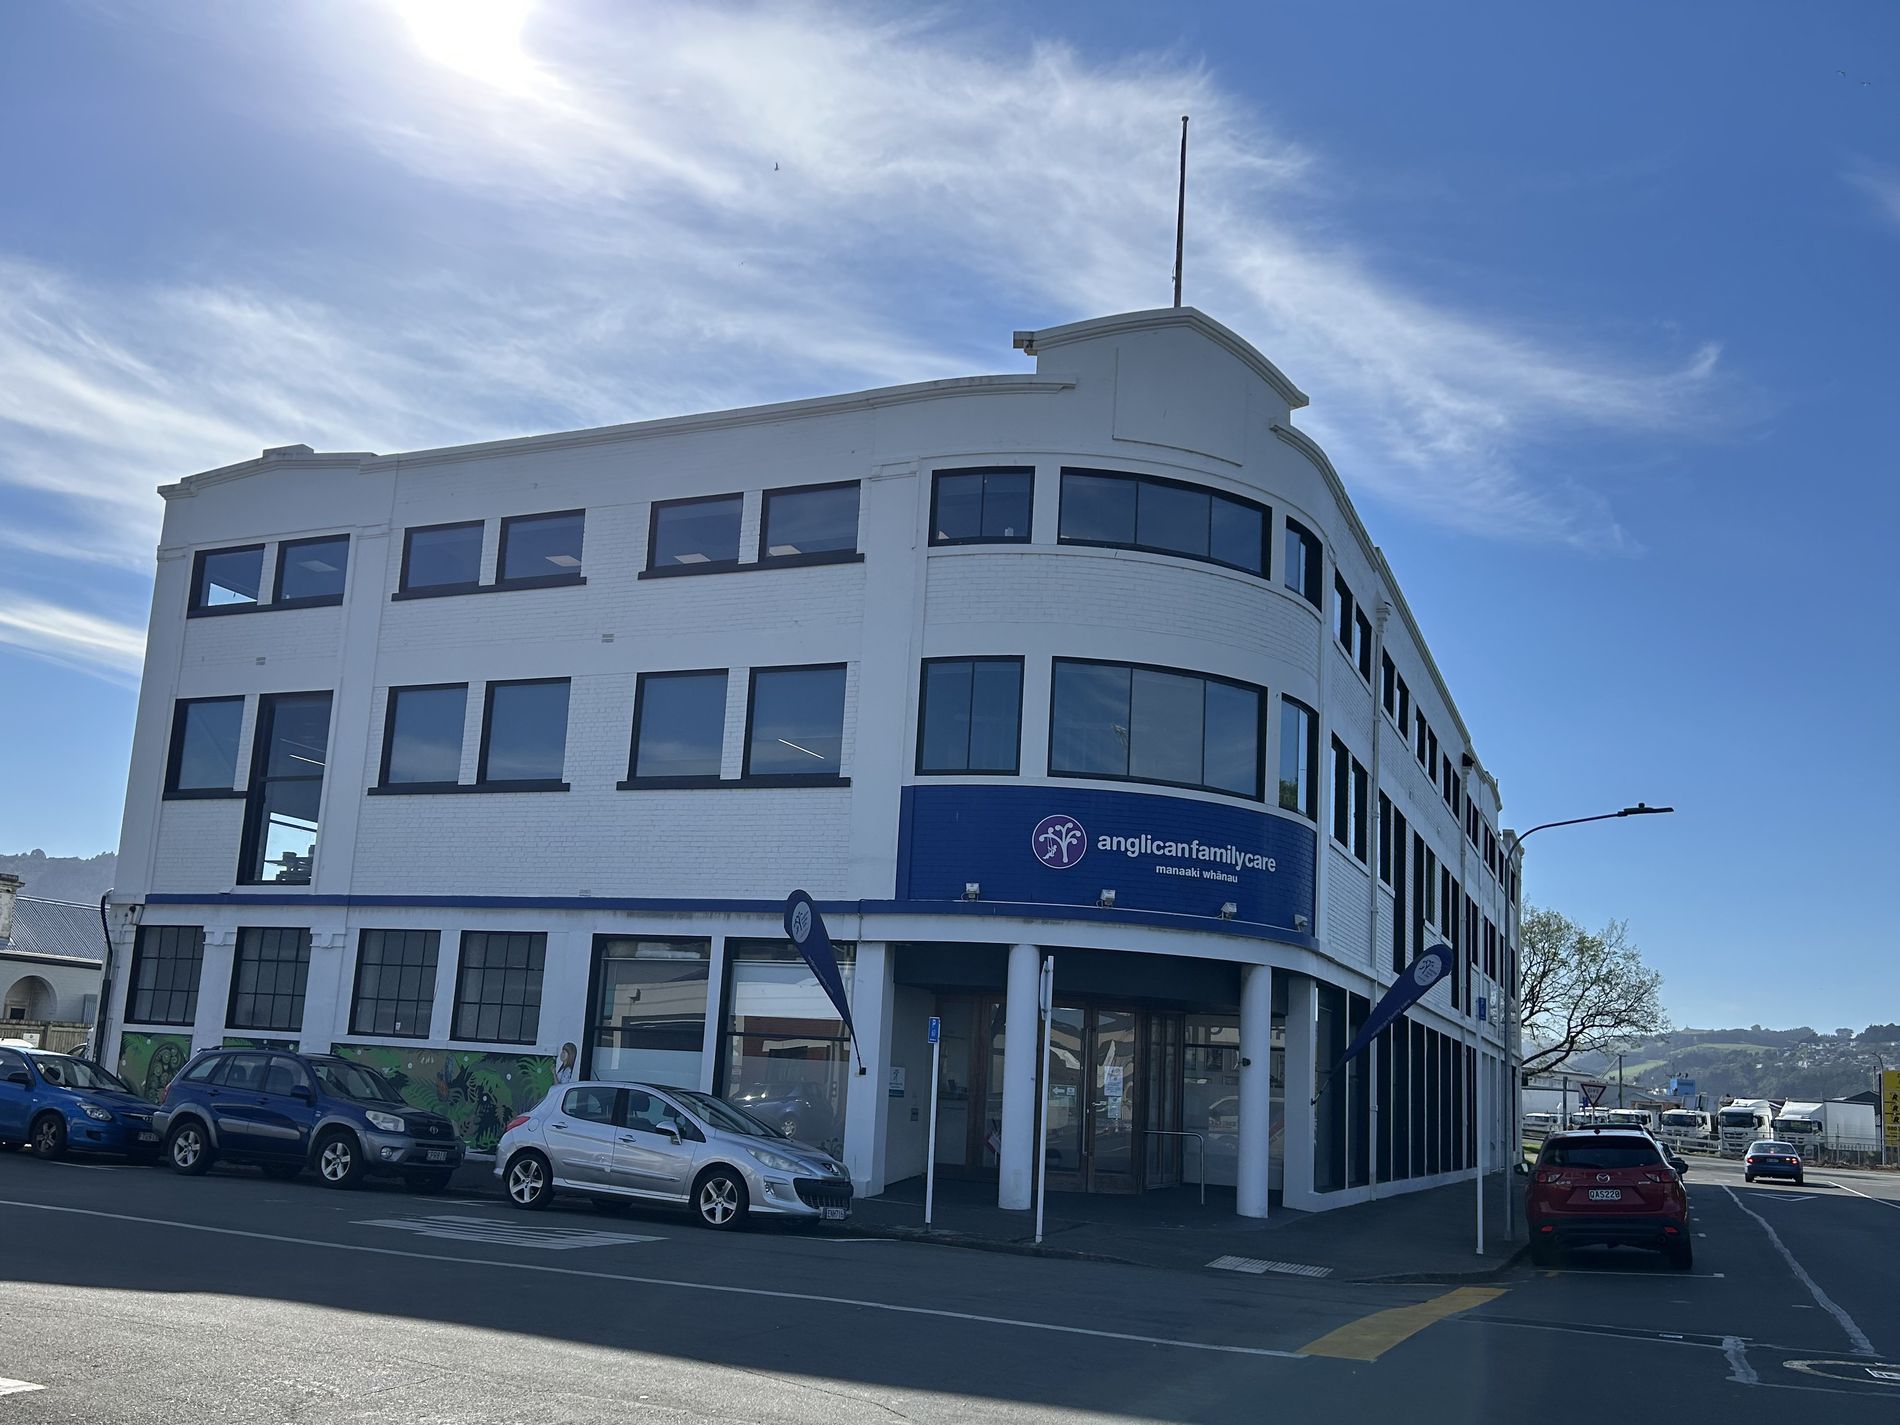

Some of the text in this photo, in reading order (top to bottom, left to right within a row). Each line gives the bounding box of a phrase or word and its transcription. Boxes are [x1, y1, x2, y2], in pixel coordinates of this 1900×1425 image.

[1097, 834, 1276, 872] anglicanfamilycare
[1156, 865, 1238, 883] manaaki whānau
